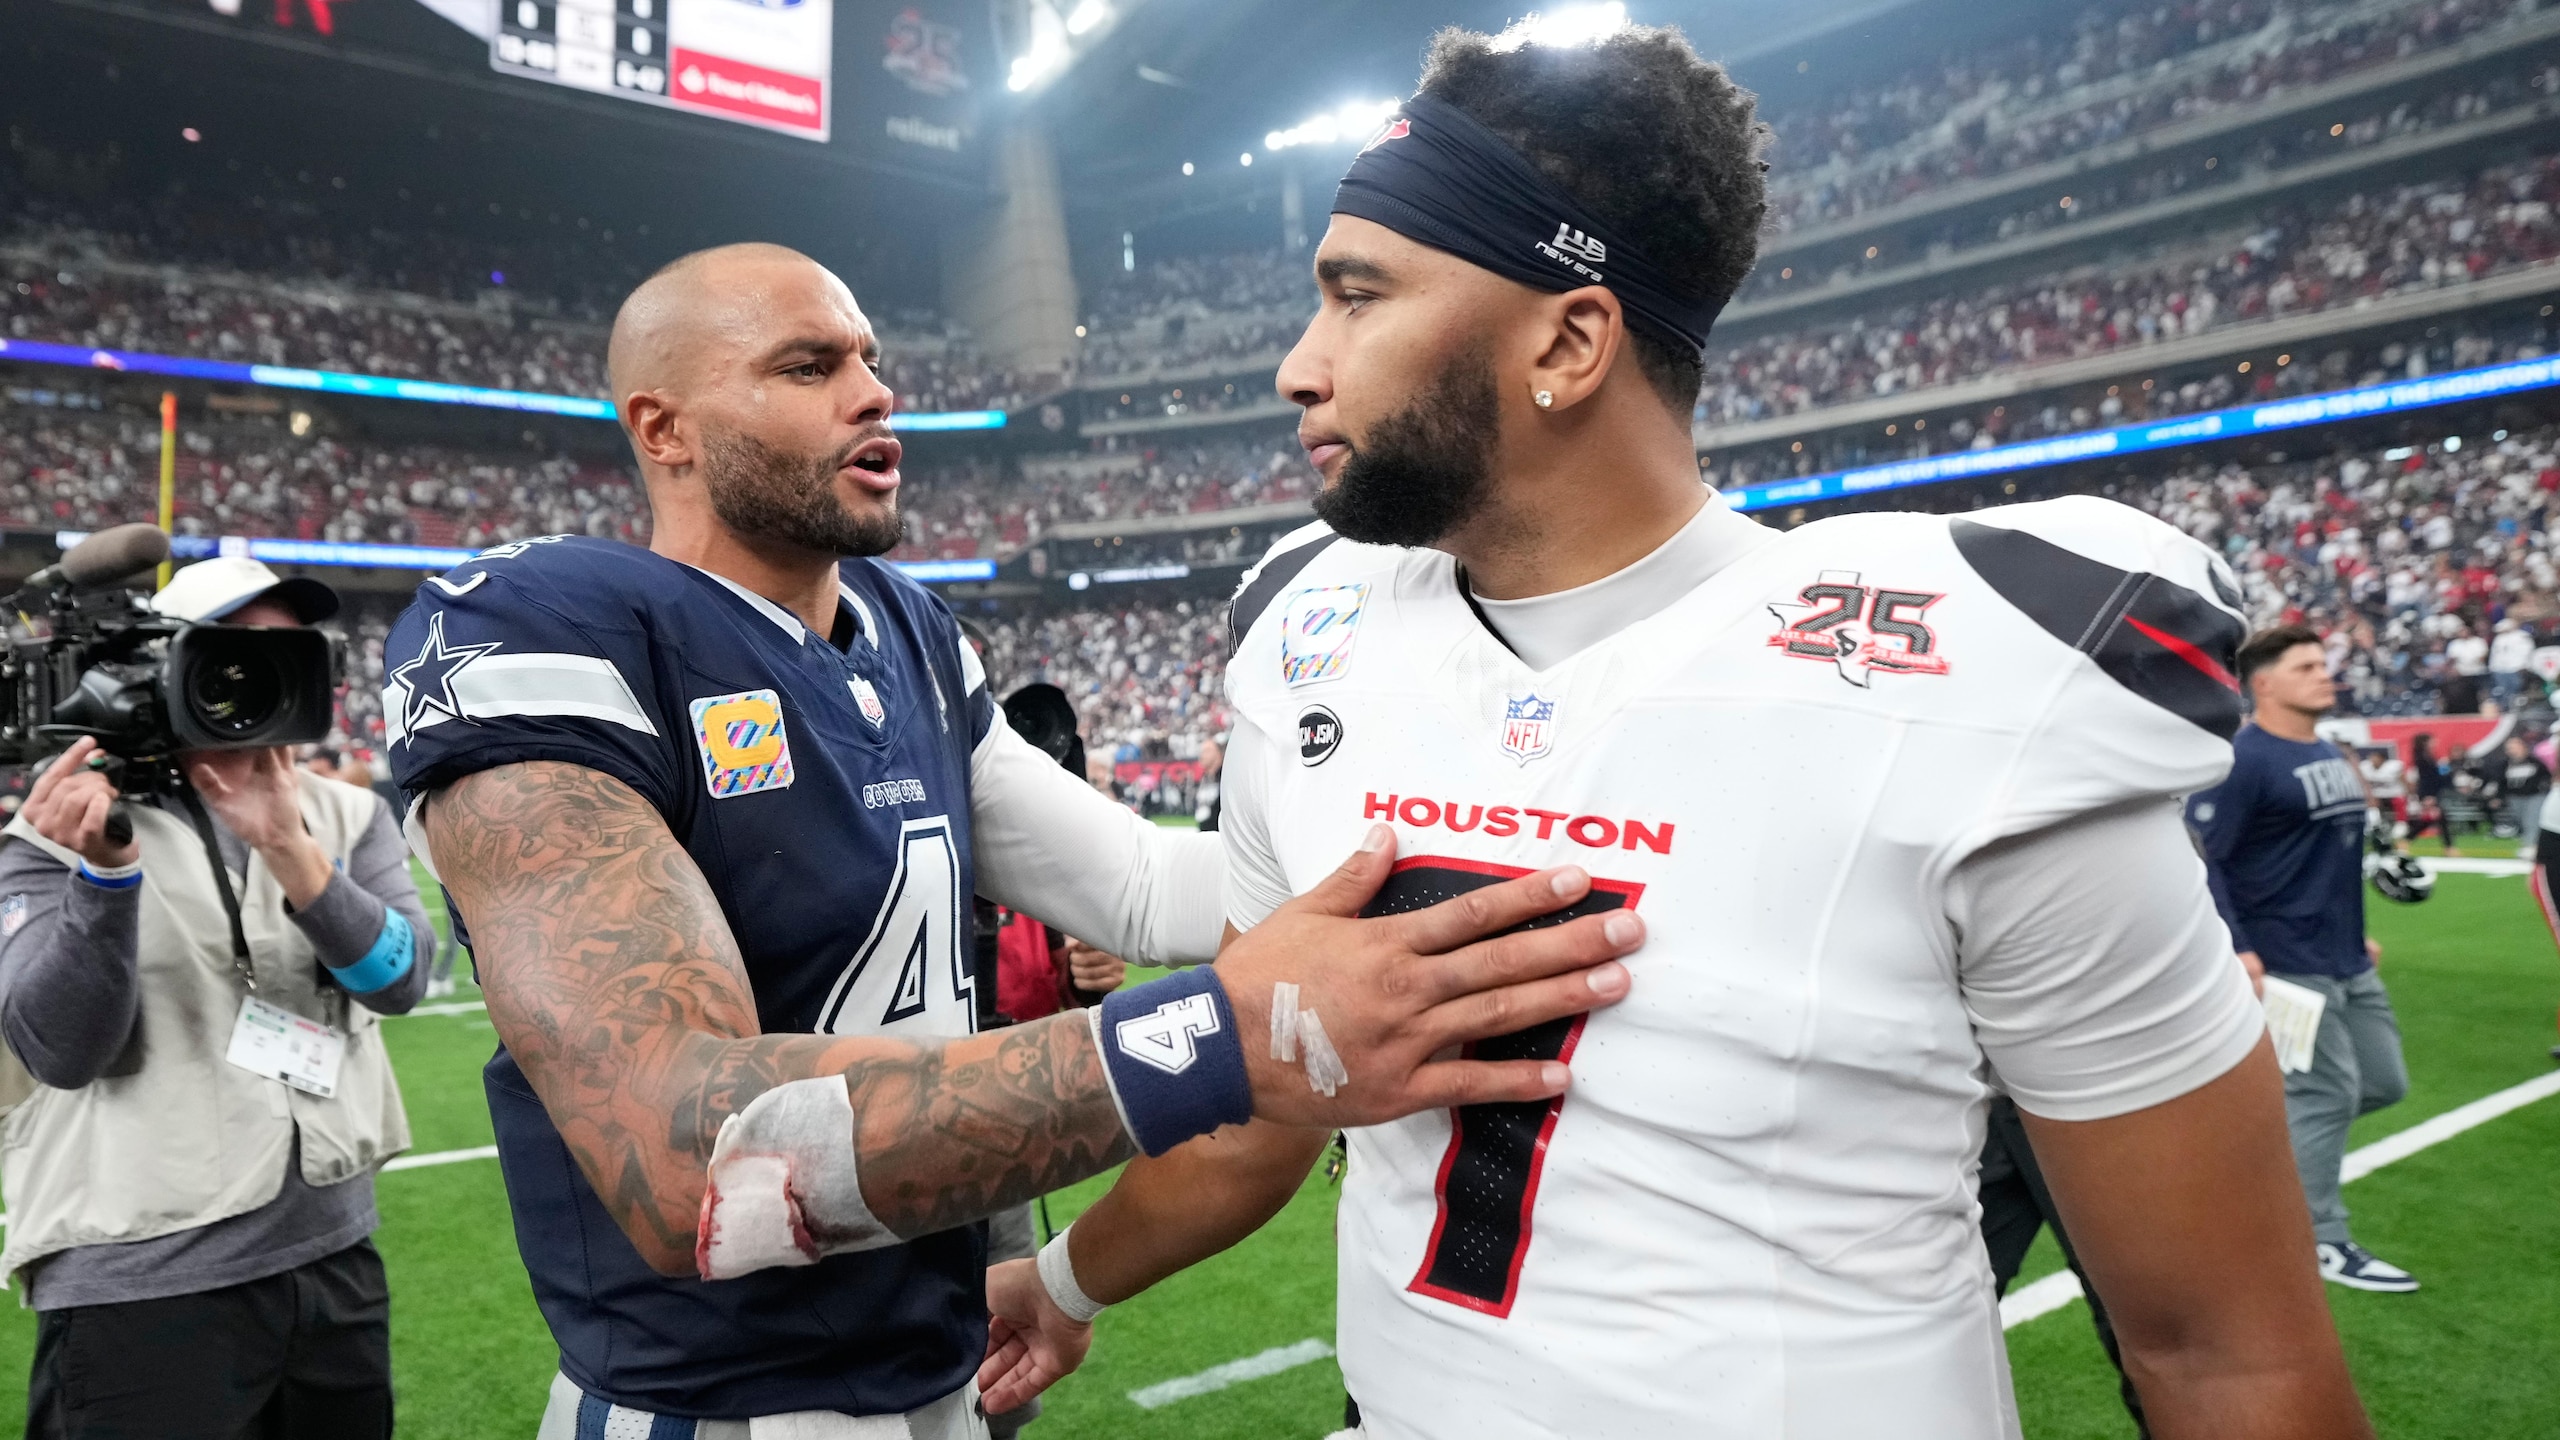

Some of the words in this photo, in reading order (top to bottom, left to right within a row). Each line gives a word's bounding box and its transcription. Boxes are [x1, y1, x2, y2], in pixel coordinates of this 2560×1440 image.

[1782, 583, 1948, 675] 25
[1804, 632, 1831, 643] 2002
[703, 698, 781, 769] C
[862, 698, 882, 718] NFL
[1506, 720, 1543, 752] NFL
[862, 779, 926, 810] COWBOYS
[1363, 791, 1676, 855] HOUSTON
[813, 814, 979, 1035] 4
[1116, 992, 1221, 1075] 4
[1355, 854, 1646, 1320] 7
